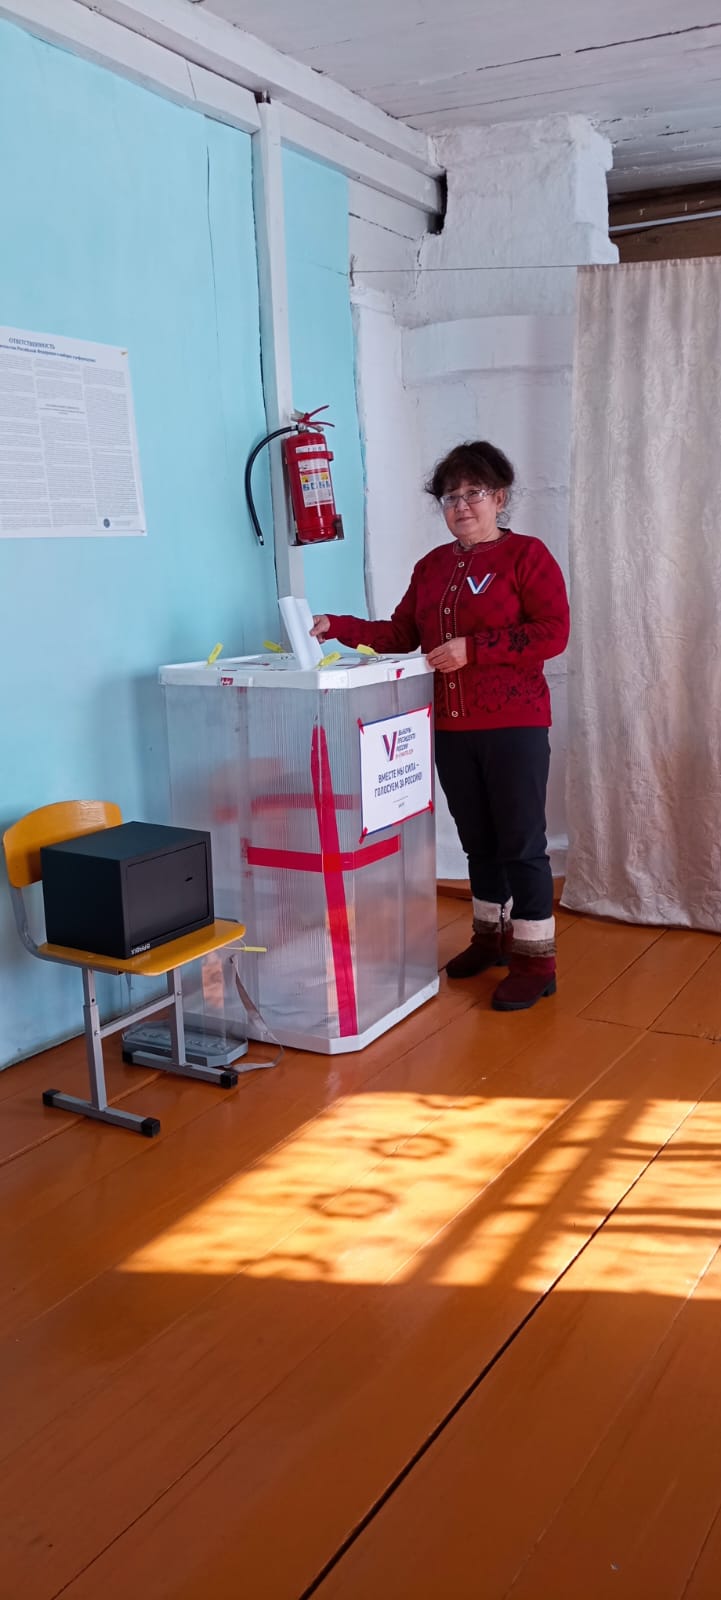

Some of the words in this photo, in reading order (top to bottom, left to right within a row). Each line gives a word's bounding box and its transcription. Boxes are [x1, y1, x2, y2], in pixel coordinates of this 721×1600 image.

[378, 769, 396, 784] ВМЕСТЕ
[396, 766, 405, 777] МЫ
[404, 762, 416, 774] СИЛА
[374, 781, 399, 798] ГОЛОСУЕМ
[399, 779, 405, 789] ЗА
